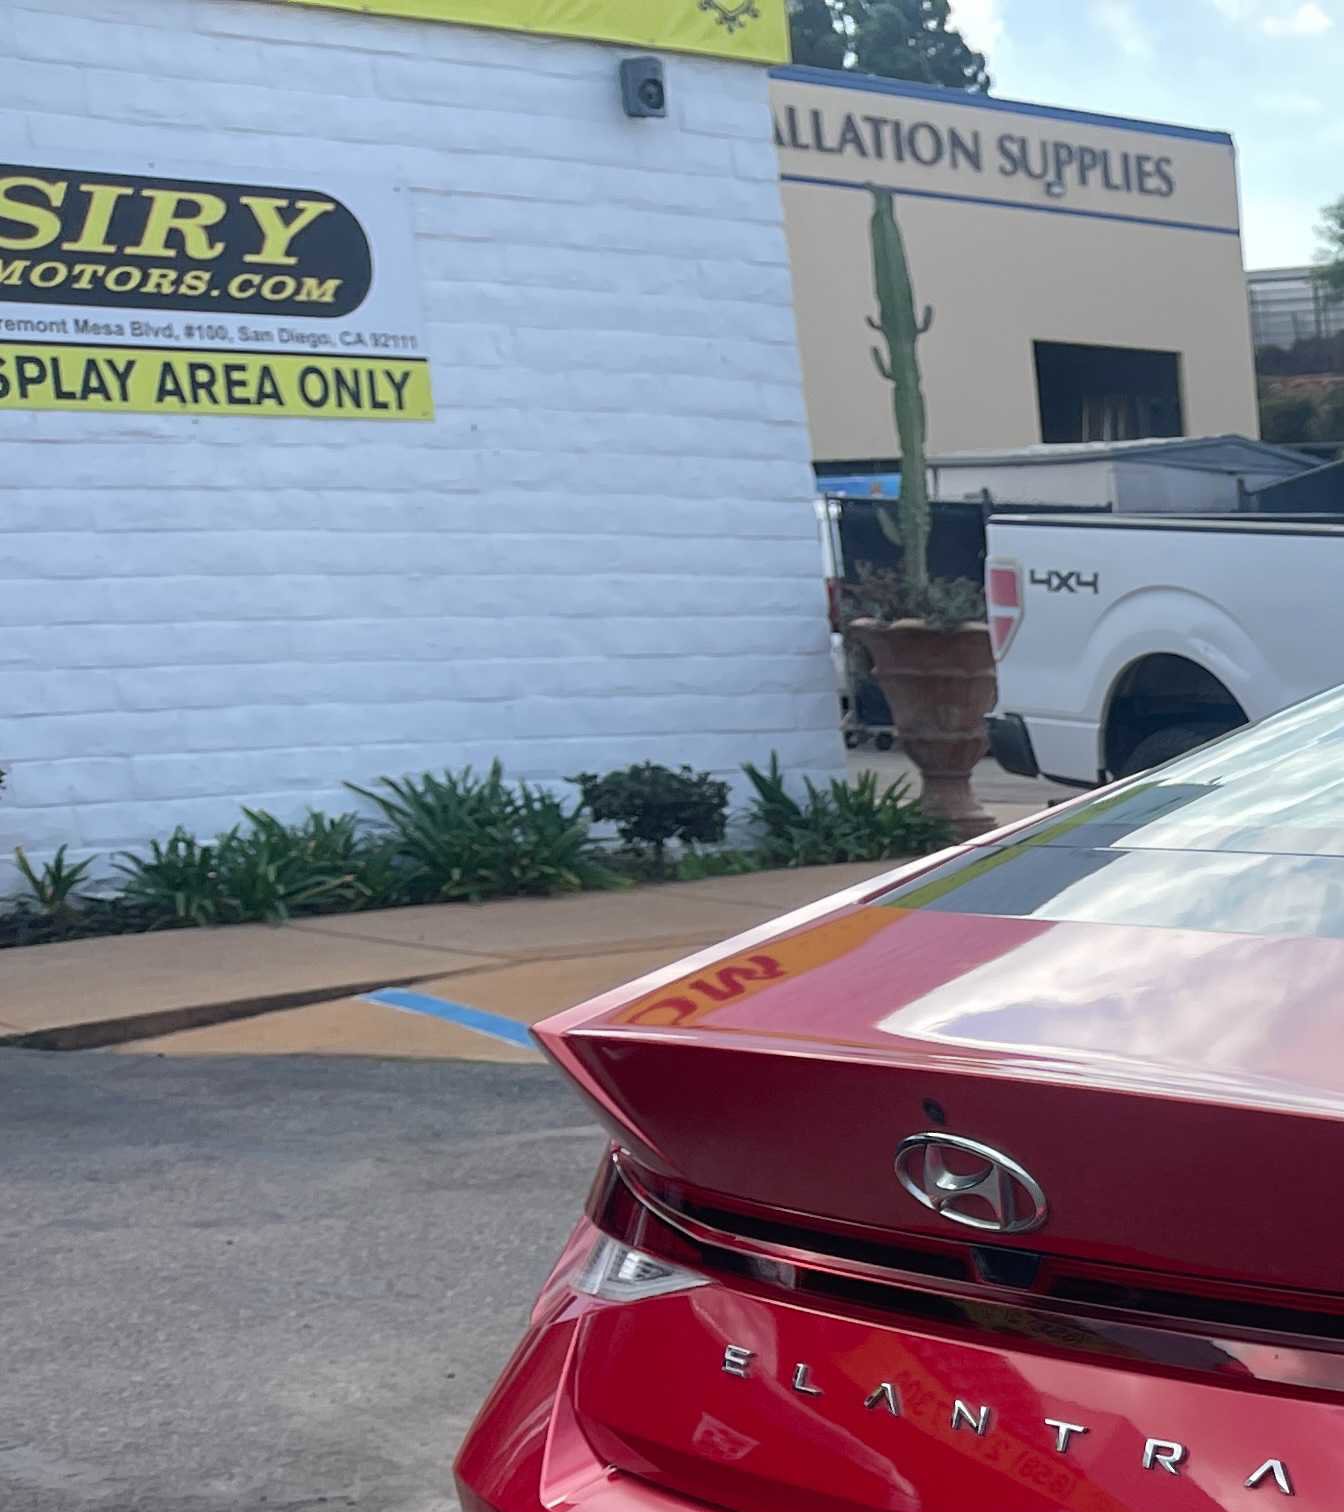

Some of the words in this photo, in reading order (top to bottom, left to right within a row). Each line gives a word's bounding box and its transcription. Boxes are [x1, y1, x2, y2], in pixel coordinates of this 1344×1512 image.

[999, 133, 1176, 197] SUPPLIES
[0, 176, 336, 266] SIRY
[0, 258, 344, 304] MOTORS.COM
[73, 319, 125, 338] Mesa
[238, 326, 273, 343] San
[339, 331, 368, 346] CA
[156, 361, 285, 406] AREA
[298, 365, 410, 410] ONLY
[720, 1343, 1296, 1497] ELANTRA
